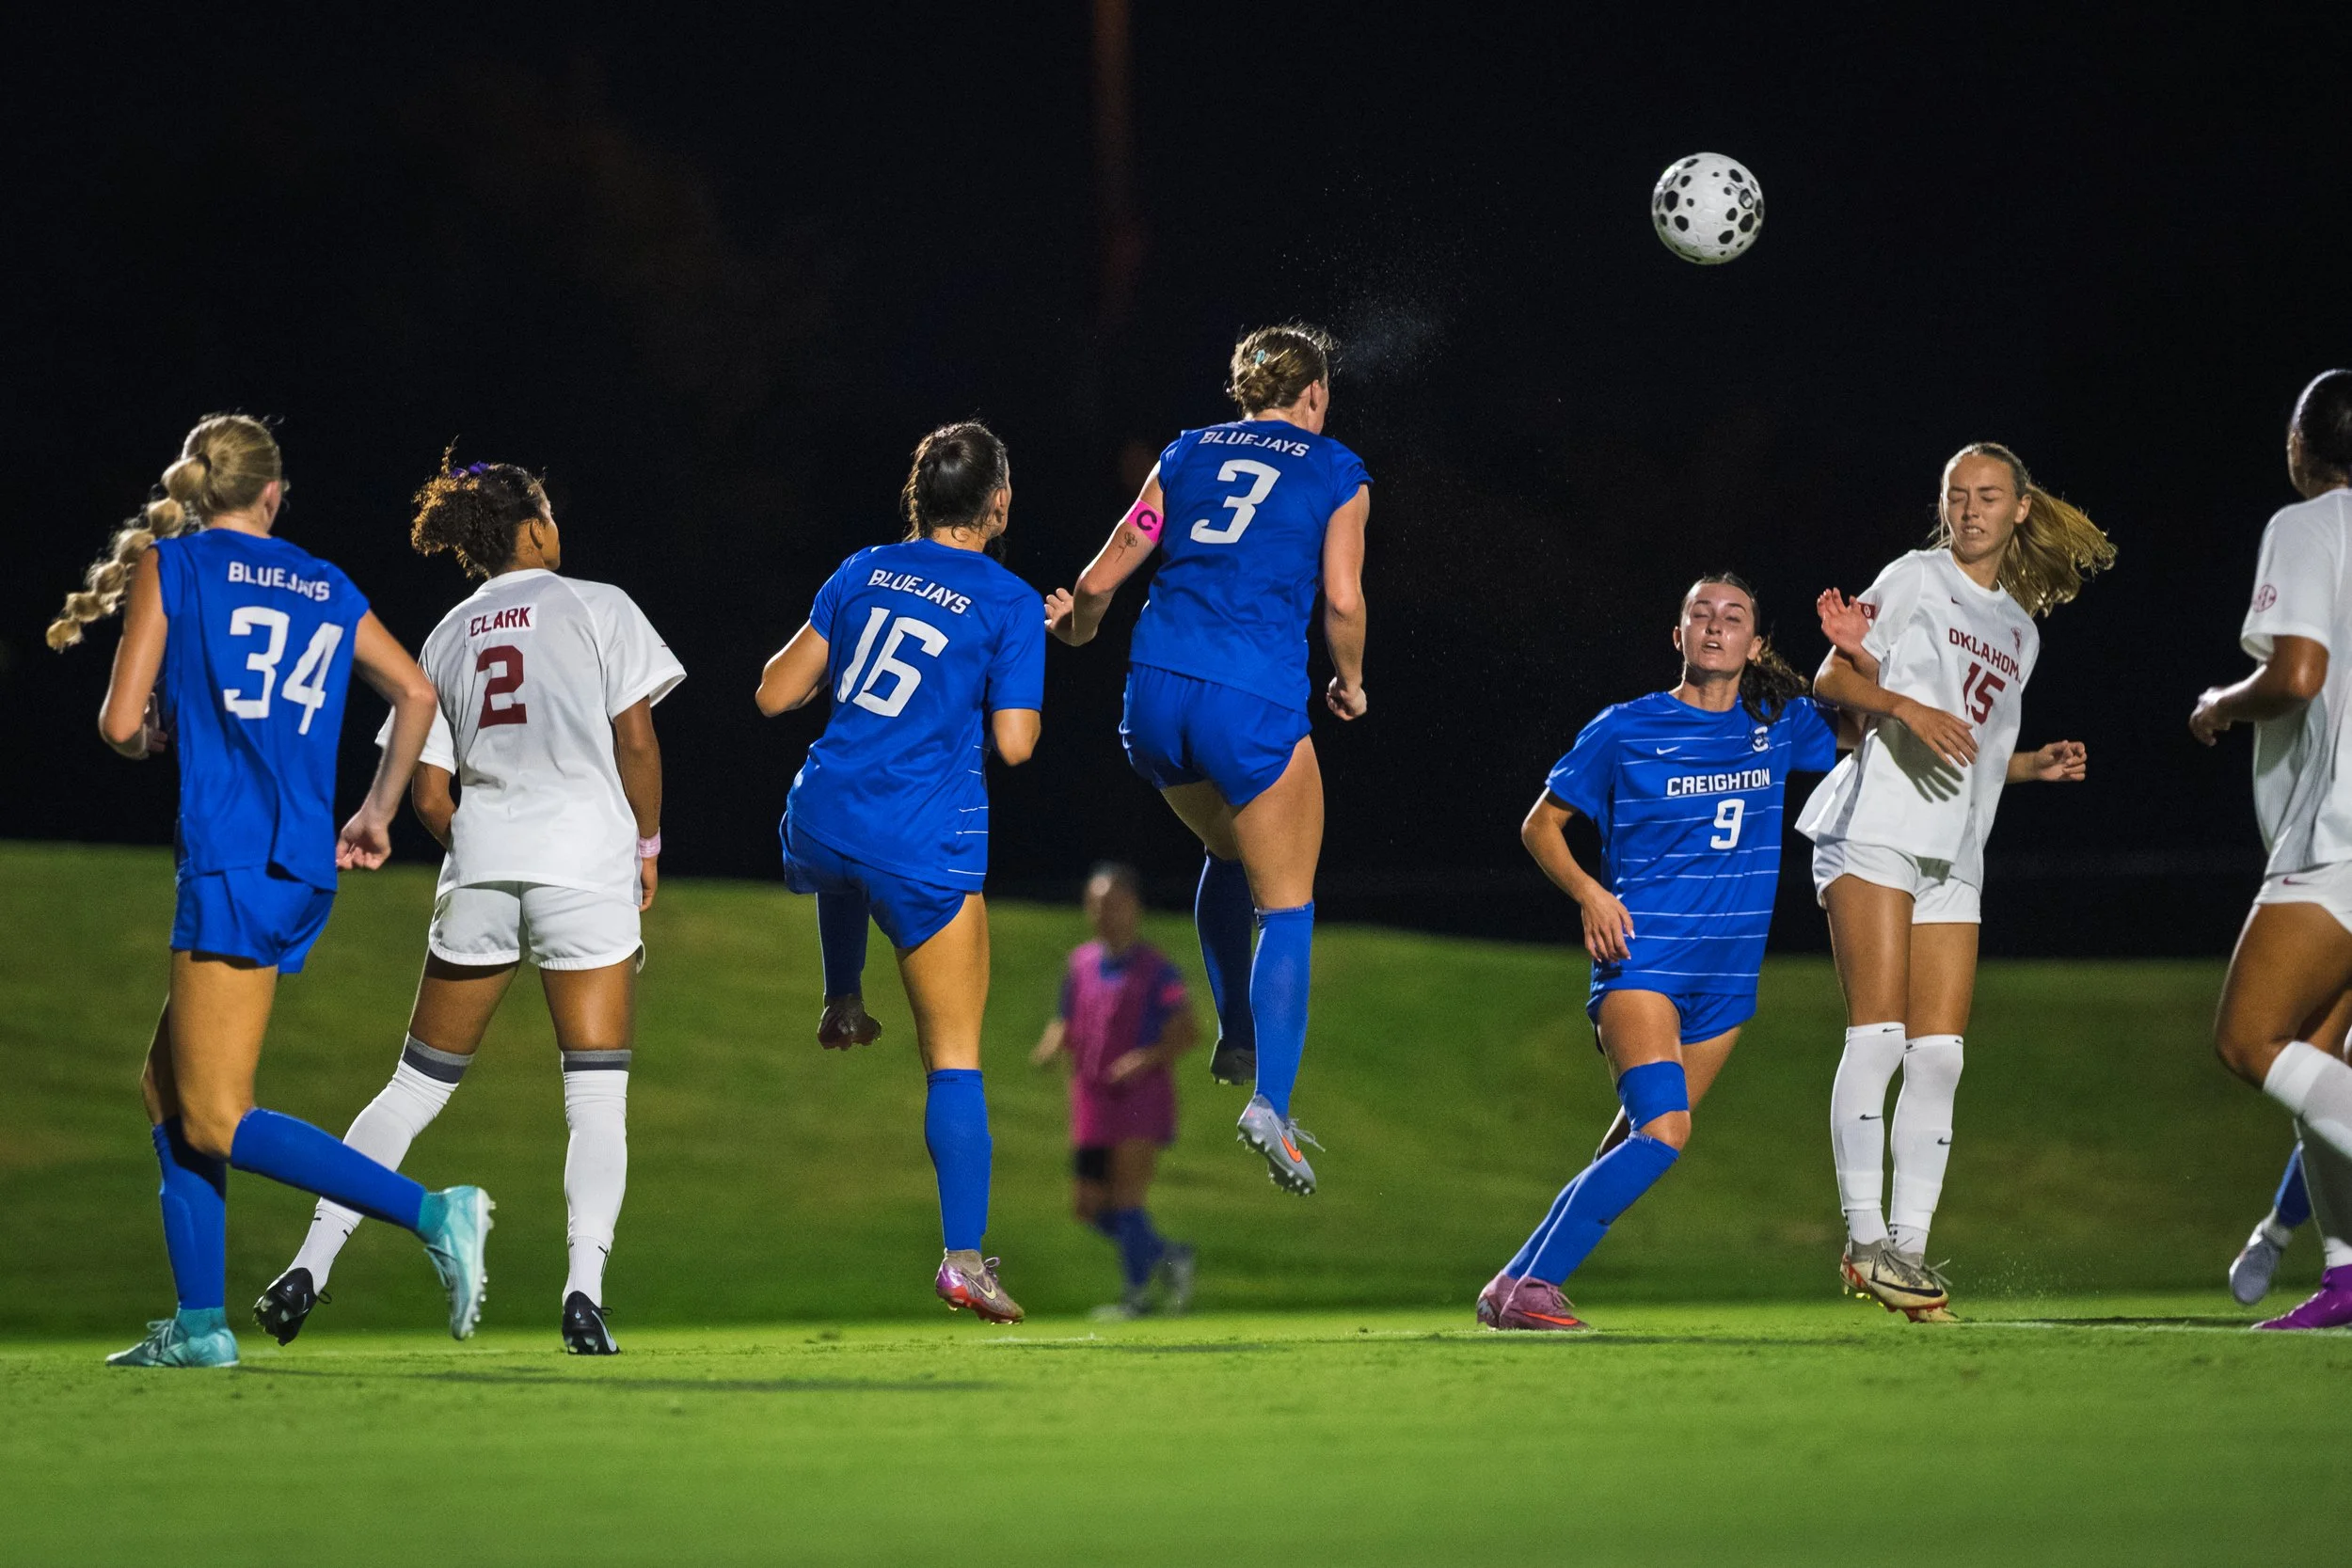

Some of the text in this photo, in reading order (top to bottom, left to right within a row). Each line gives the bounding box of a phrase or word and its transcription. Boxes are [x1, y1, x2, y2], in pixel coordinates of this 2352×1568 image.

[1199, 431, 1310, 457] BLUEJAYS
[1136, 510, 1158, 531] C
[1190, 459, 1281, 545] 3
[867, 569, 972, 614] BLUEJAYS
[470, 607, 531, 637] CLARK
[223, 606, 344, 736] 34
[837, 607, 949, 718] 16
[1948, 627, 2022, 684] OKLAHOM
[477, 645, 528, 729] 2
[1963, 661, 2006, 726] 15
[1666, 768, 1771, 797] CREIGHTON
[1710, 798, 1745, 849] 9
